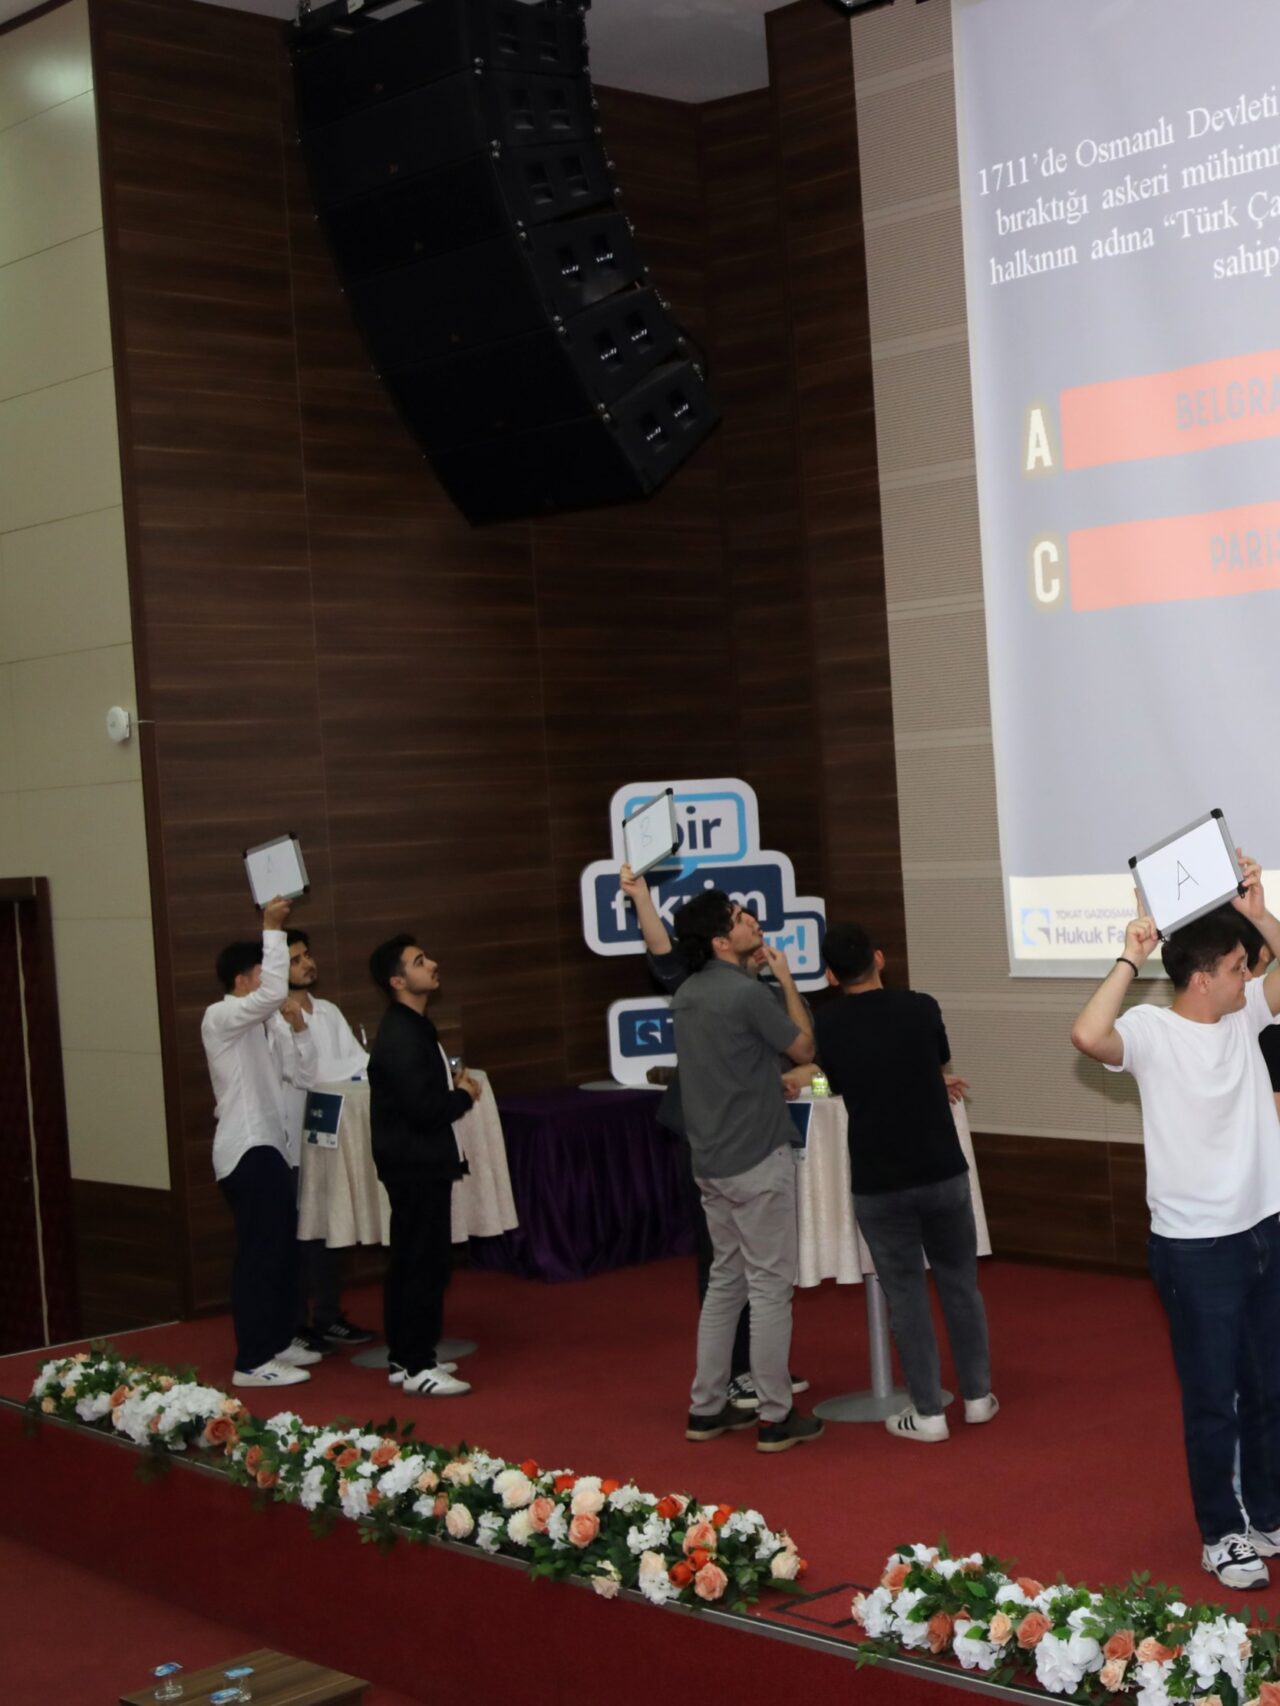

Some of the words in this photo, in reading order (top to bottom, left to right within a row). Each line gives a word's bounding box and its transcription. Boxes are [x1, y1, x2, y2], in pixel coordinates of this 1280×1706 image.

[1075, 115, 1175, 168] Osmanlı
[995, 188, 1090, 236] bıraktığı
[1101, 163, 1171, 210] askeri
[989, 243, 1080, 286] halkının
[1090, 226, 1155, 261] adına
[1162, 198, 1239, 239] “Türk
[1025, 407, 1053, 471] A
[1032, 540, 1061, 604] C
[1176, 860, 1200, 901] A
[1055, 926, 1104, 945] Hukuk
